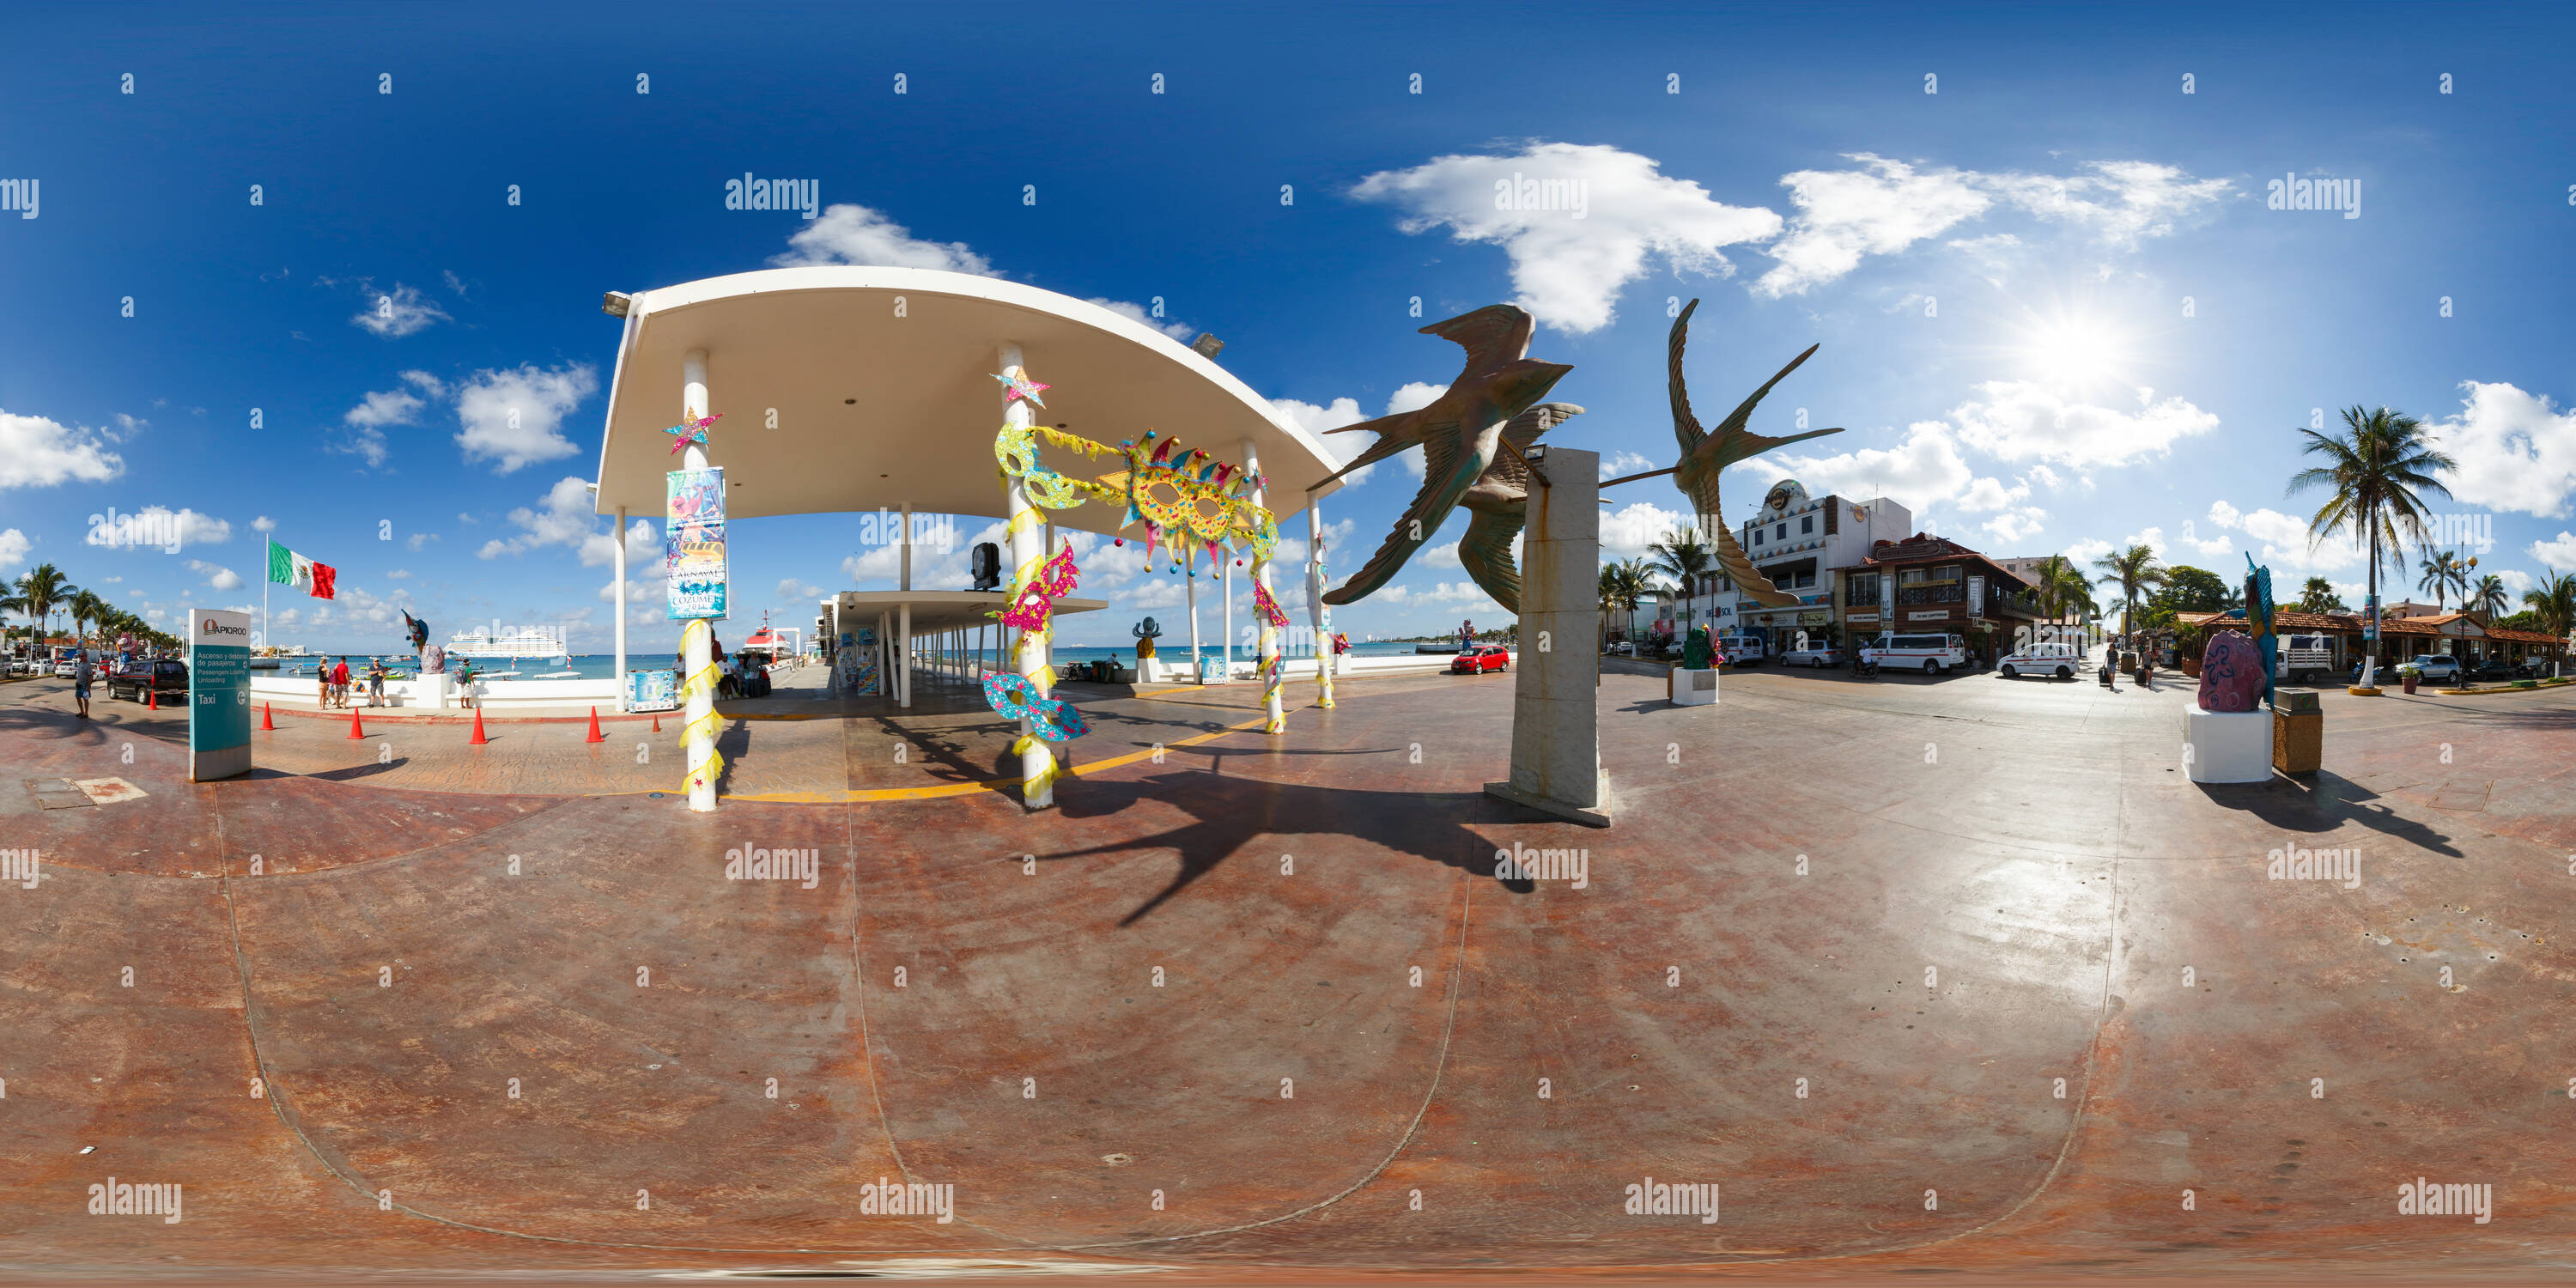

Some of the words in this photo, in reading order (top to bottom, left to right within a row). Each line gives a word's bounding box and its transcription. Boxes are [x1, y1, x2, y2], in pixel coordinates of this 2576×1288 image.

[670, 570, 719, 580] CARNAVAL
[1721, 607, 1732, 617] SOL
[197, 693, 216, 705] Taxi
